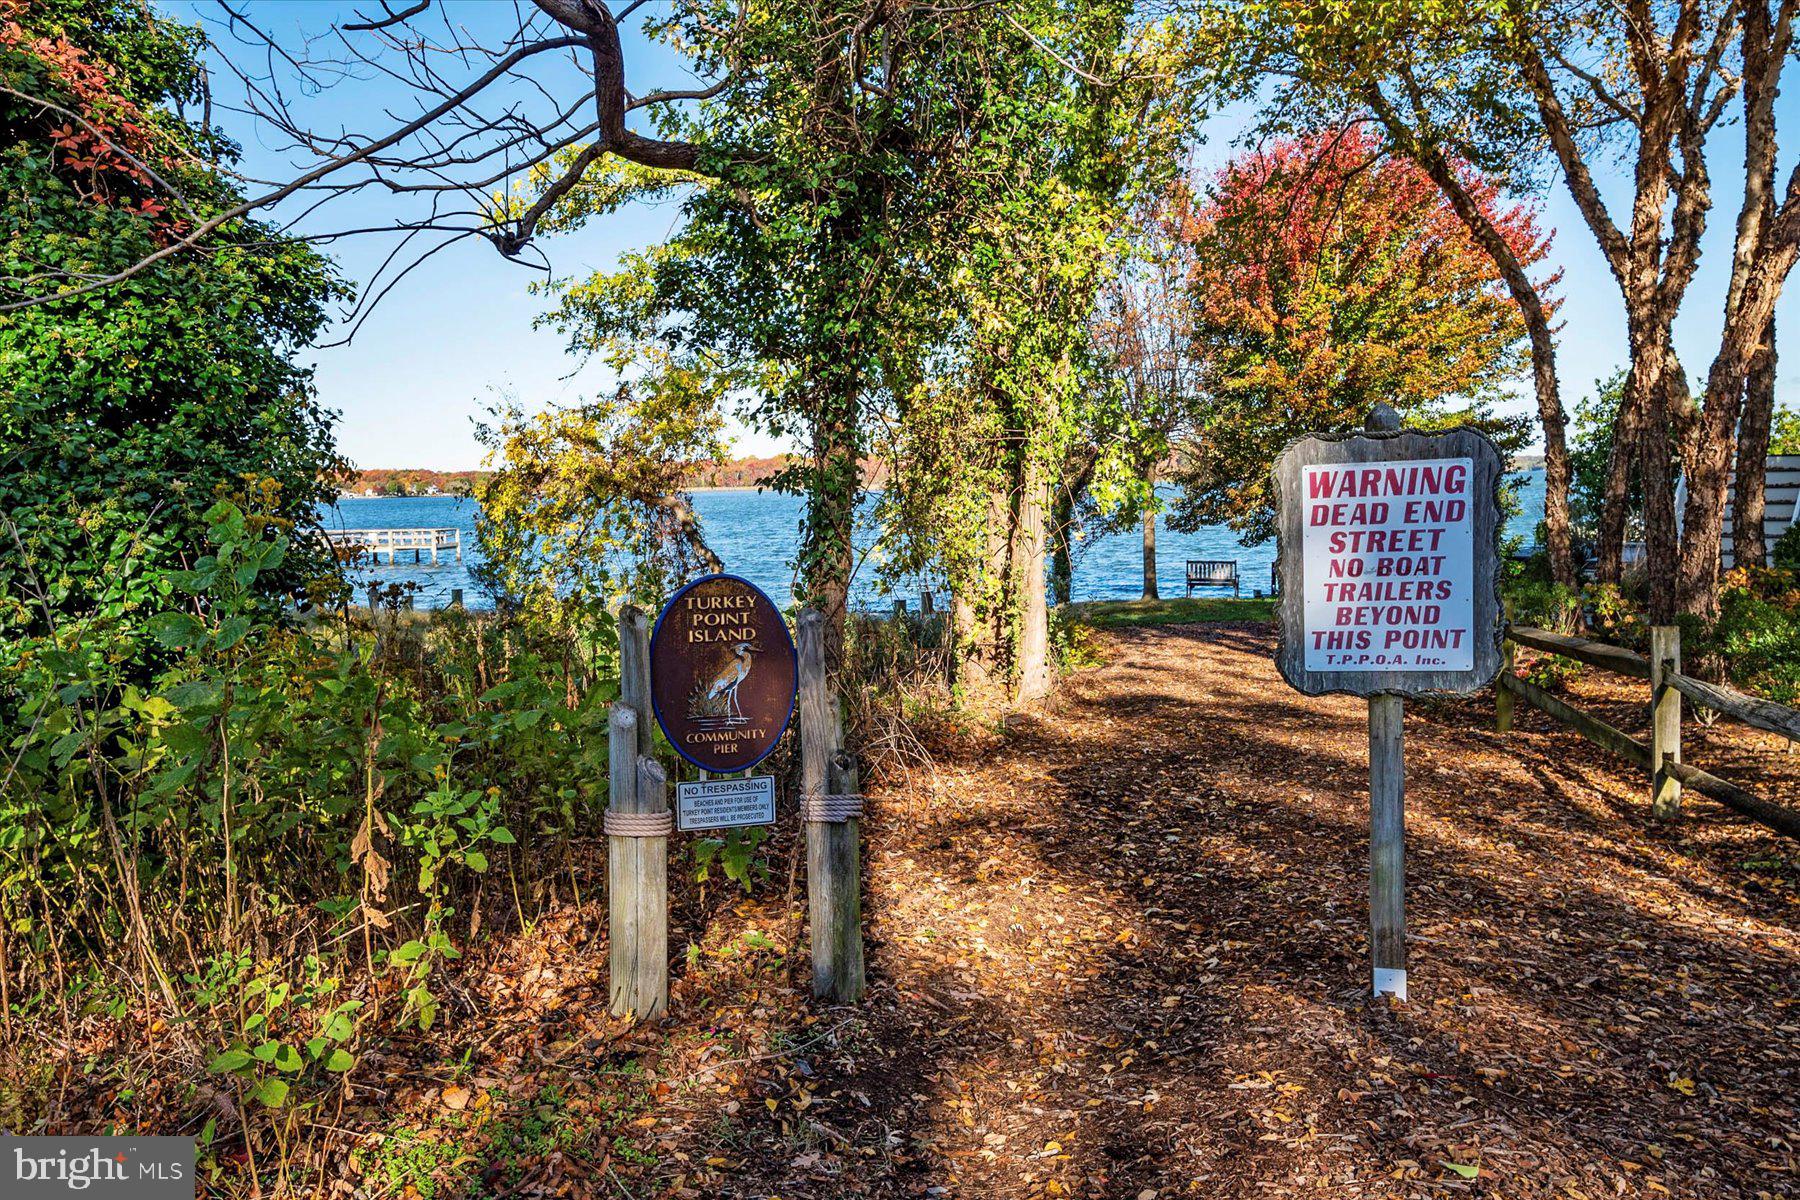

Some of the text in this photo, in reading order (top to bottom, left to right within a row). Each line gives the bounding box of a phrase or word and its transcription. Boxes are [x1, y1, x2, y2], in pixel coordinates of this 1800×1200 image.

[1308, 465, 1467, 499] WARNING
[1310, 499, 1466, 527] DEAD END
[1328, 528, 1446, 554] STREET
[1329, 556, 1446, 578] NO BOAT
[1324, 580, 1453, 603] TRAILERS
[685, 595, 759, 611] TURKEY
[693, 611, 751, 627] POINT
[1335, 605, 1441, 626] BEYOND
[688, 627, 757, 643] ISLAND
[1312, 628, 1466, 651] THIS POINT
[1327, 654, 1446, 666] T.P.P.O.A. Inc.
[686, 727, 768, 744] COMMUNITY
[713, 743, 739, 754] PIER
[684, 782, 768, 796] NO TRESPASSING
[694, 798, 714, 807] BEACHES
[714, 798, 724, 806] AND
[724, 797, 734, 805] PIER
[734, 796, 743, 804] FOR
[752, 795, 759, 803] OF
[682, 808, 701, 817] TURKEY
[701, 807, 714, 816] POINT
[758, 803, 770, 811] ONLY
[689, 812, 764, 825] TRESPASSERS WILL BE PROSECUTED
